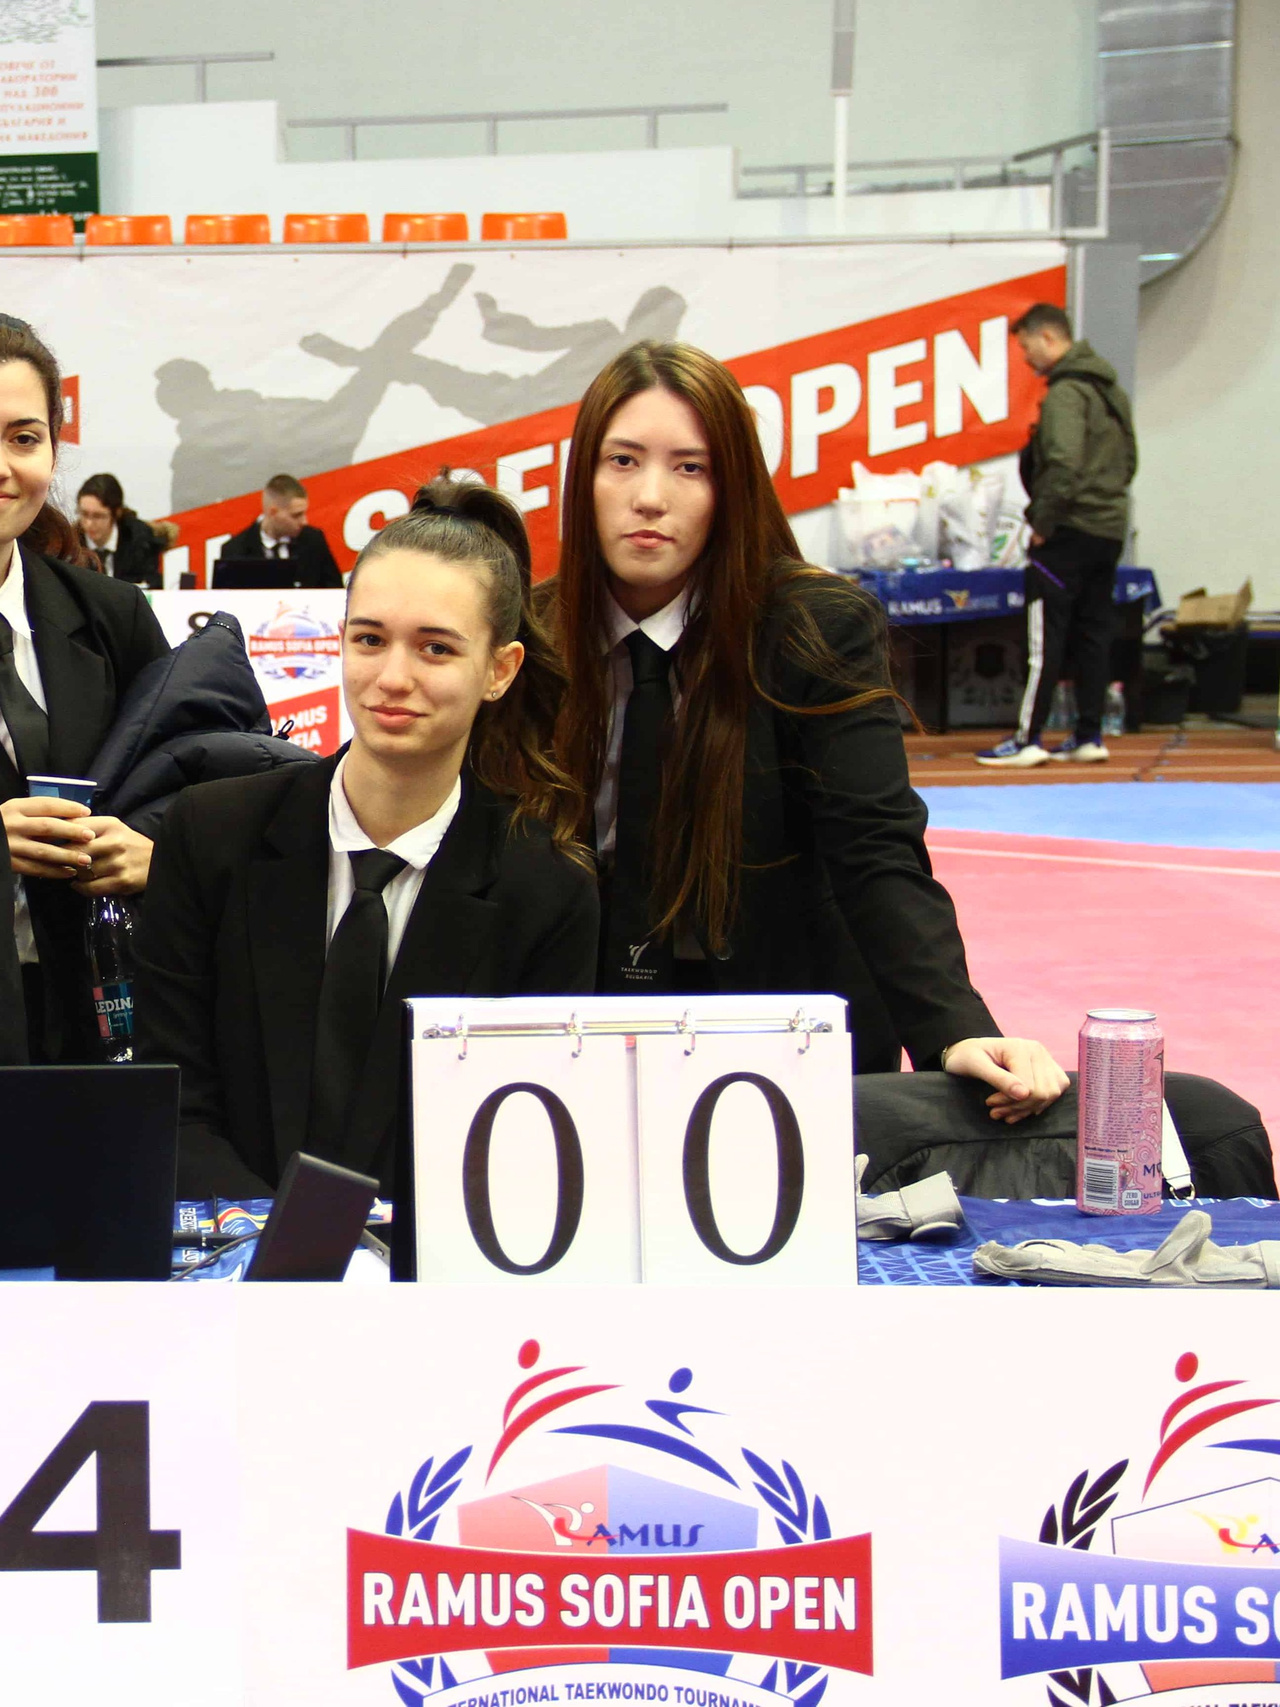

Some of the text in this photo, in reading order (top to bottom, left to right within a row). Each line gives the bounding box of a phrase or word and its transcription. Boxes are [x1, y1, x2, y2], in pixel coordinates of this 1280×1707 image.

[94, 996, 134, 1014] LEDIN
[462, 1071, 806, 1276] 0 0
[363, 1571, 857, 1632] RAMUS SOFIA OPEN
[1012, 1581, 1219, 1645] RAMUS
[564, 1682, 669, 1702] TAEKWONDO
